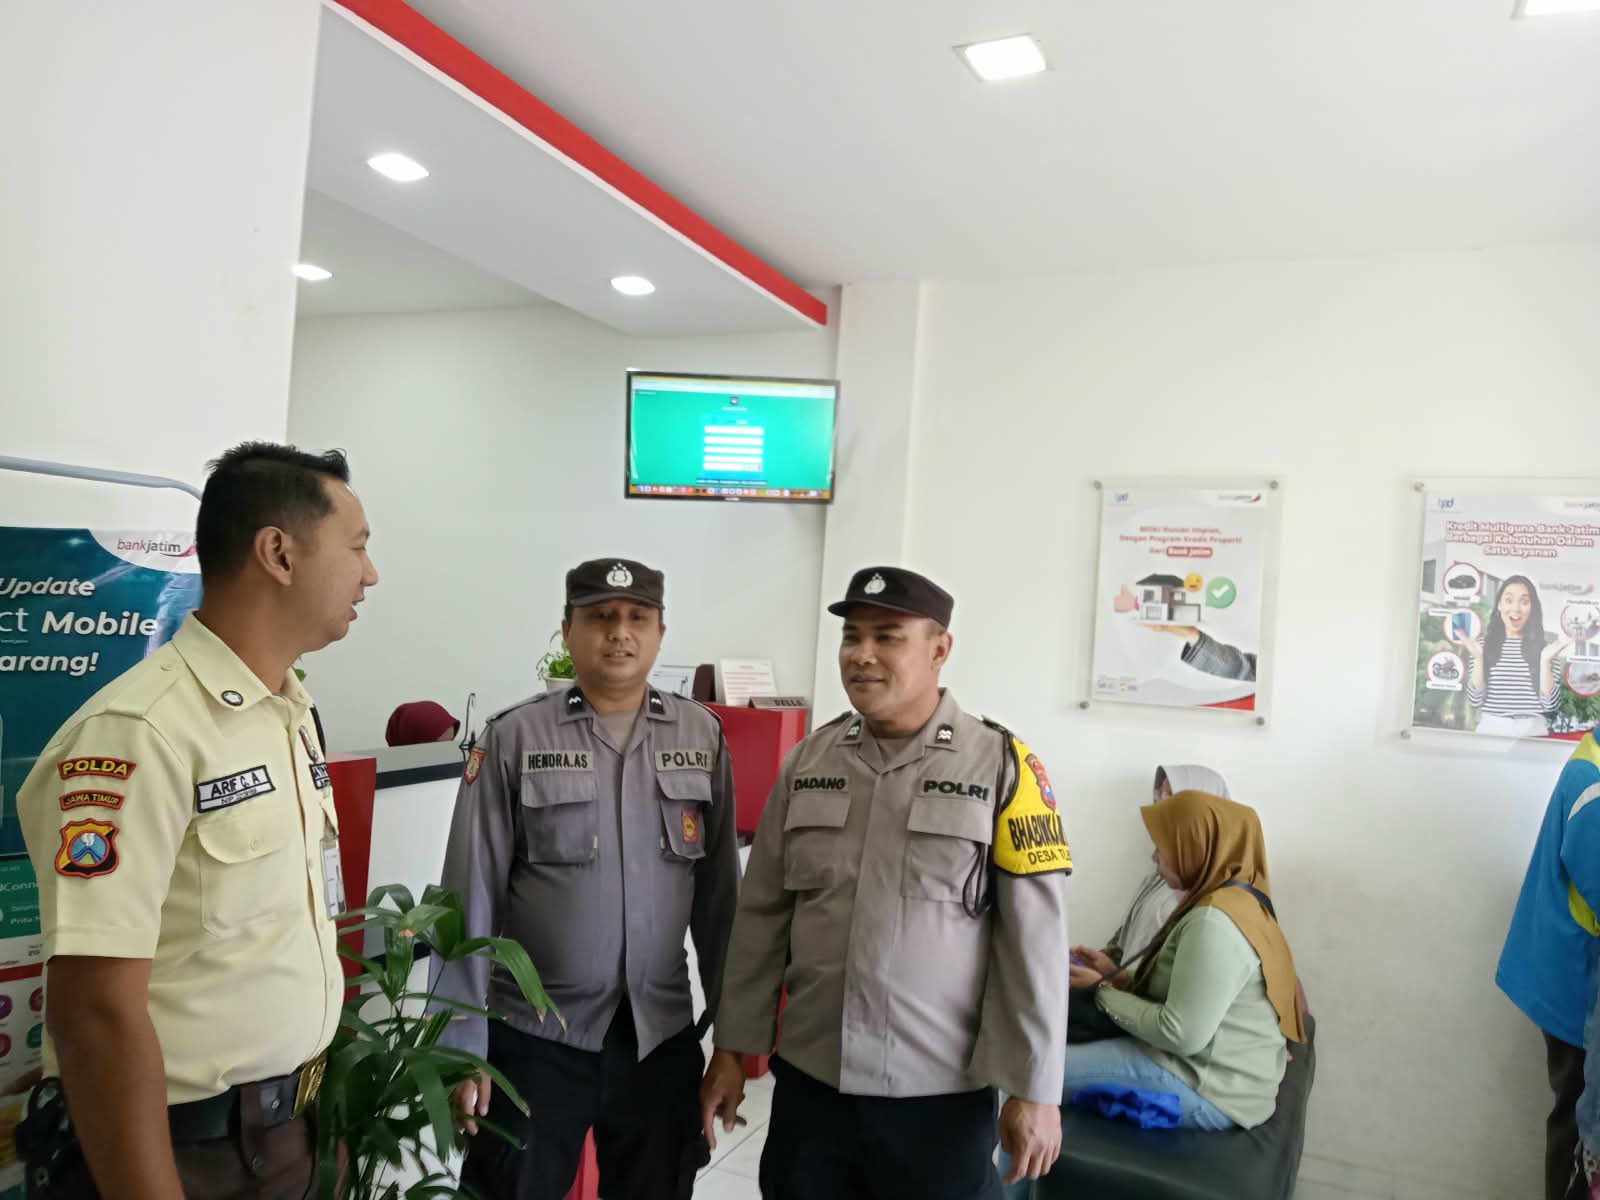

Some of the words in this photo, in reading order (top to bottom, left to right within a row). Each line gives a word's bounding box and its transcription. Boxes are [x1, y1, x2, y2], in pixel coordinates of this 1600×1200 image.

[1447, 521, 1478, 532] Kredit
[1479, 522, 1535, 534] Multiguna
[1537, 524, 1567, 534] Bank
[117, 537, 181, 554] bankjatim
[1495, 534, 1555, 545] Kebutuhan
[1556, 536, 1594, 547] Dalam
[1485, 546, 1508, 556] Satu
[1511, 547, 1557, 558] Layanan
[0, 576, 96, 599] Update
[41, 610, 160, 636] Mobile
[0, 651, 100, 677] arang!
[62, 759, 128, 775] POLDA
[527, 753, 588, 769] HENDRA.AS
[661, 751, 708, 768] POLRI
[210, 777, 238, 799] ARIF
[252, 771, 261, 785] A
[793, 777, 847, 791] DADANG
[923, 779, 989, 801] POLRI
[65, 793, 90, 805] JAWA
[92, 793, 120, 805] TIMUR
[1027, 849, 1057, 865] DESA
